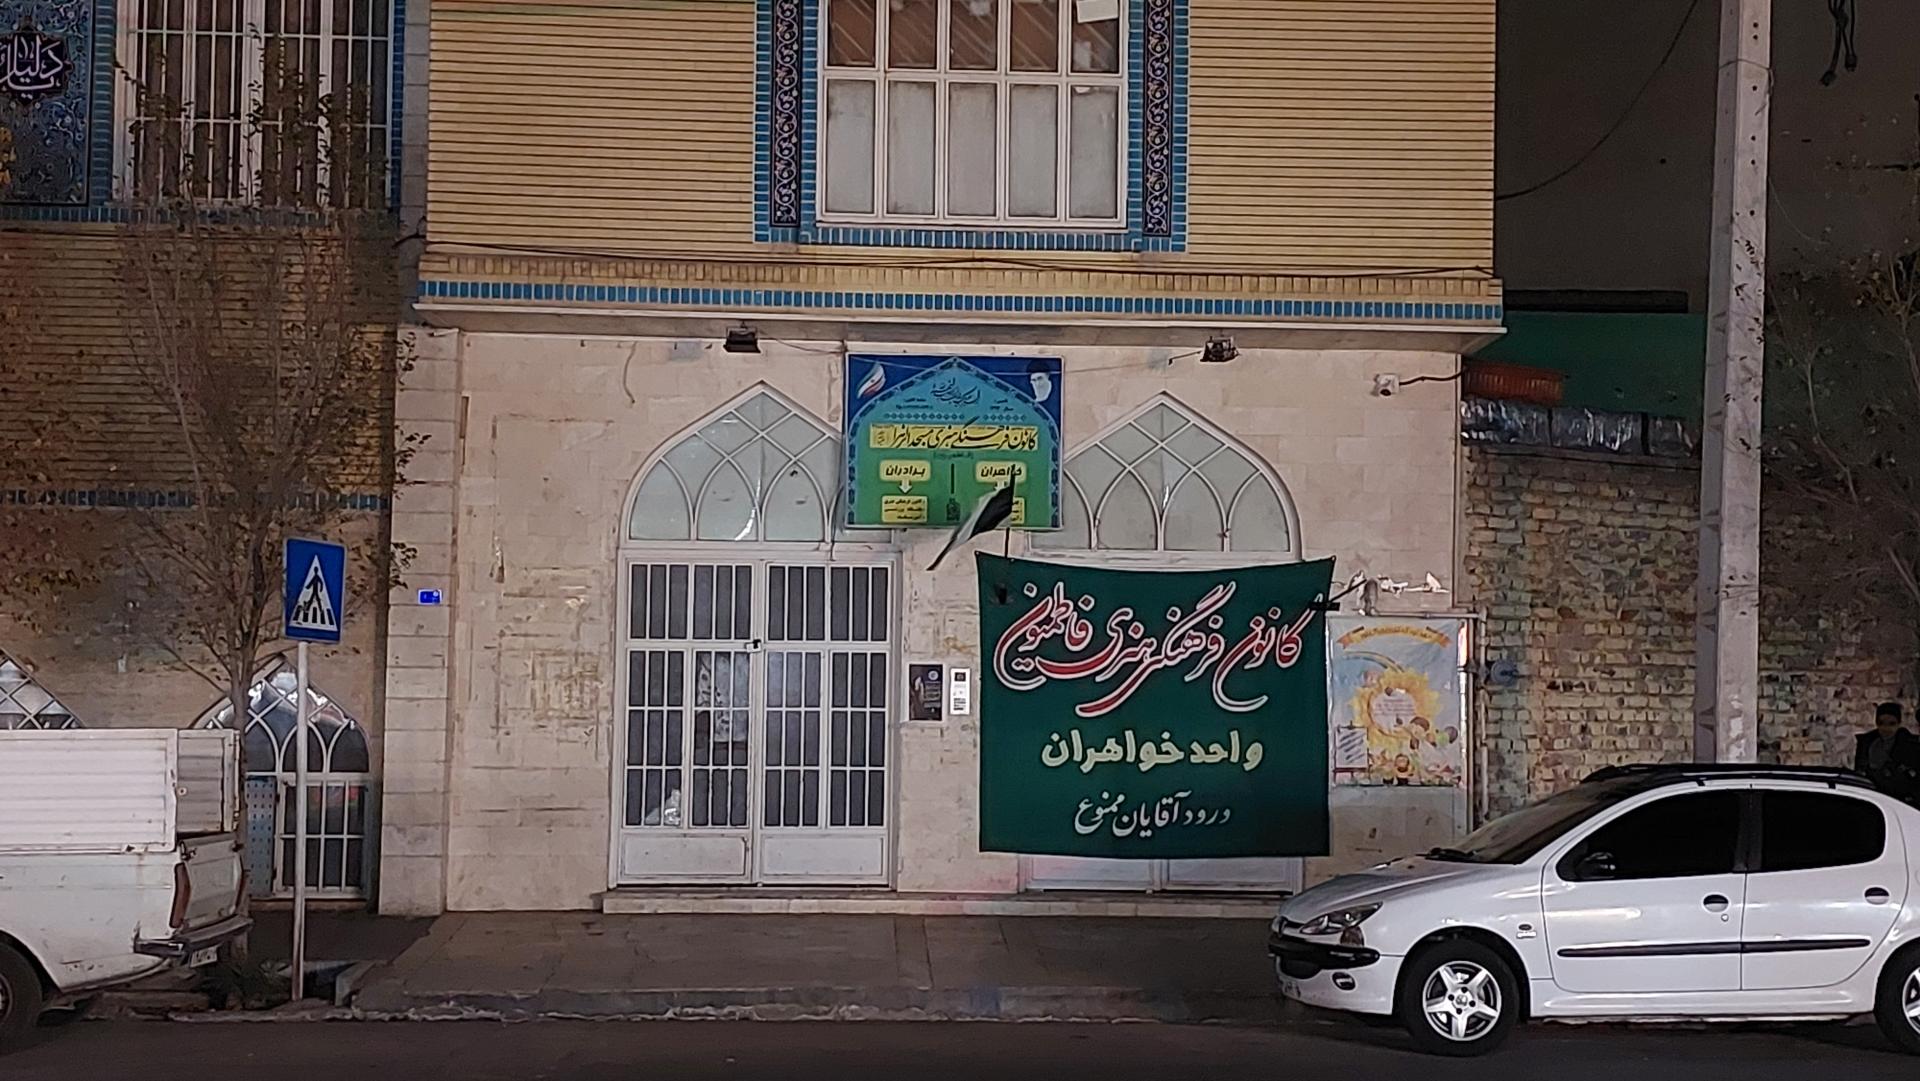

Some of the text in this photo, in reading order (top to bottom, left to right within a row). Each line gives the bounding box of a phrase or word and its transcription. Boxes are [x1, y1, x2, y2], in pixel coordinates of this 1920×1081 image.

[1009, 431, 1036, 450] کانون
[885, 465, 926, 476] برادران
[994, 581, 1324, 717] کانون فرهنگی هنری فاطمیون
[1041, 729, 1264, 774] واحد خواهران
[1074, 791, 1231, 838] ورود آقایان ممنوع
